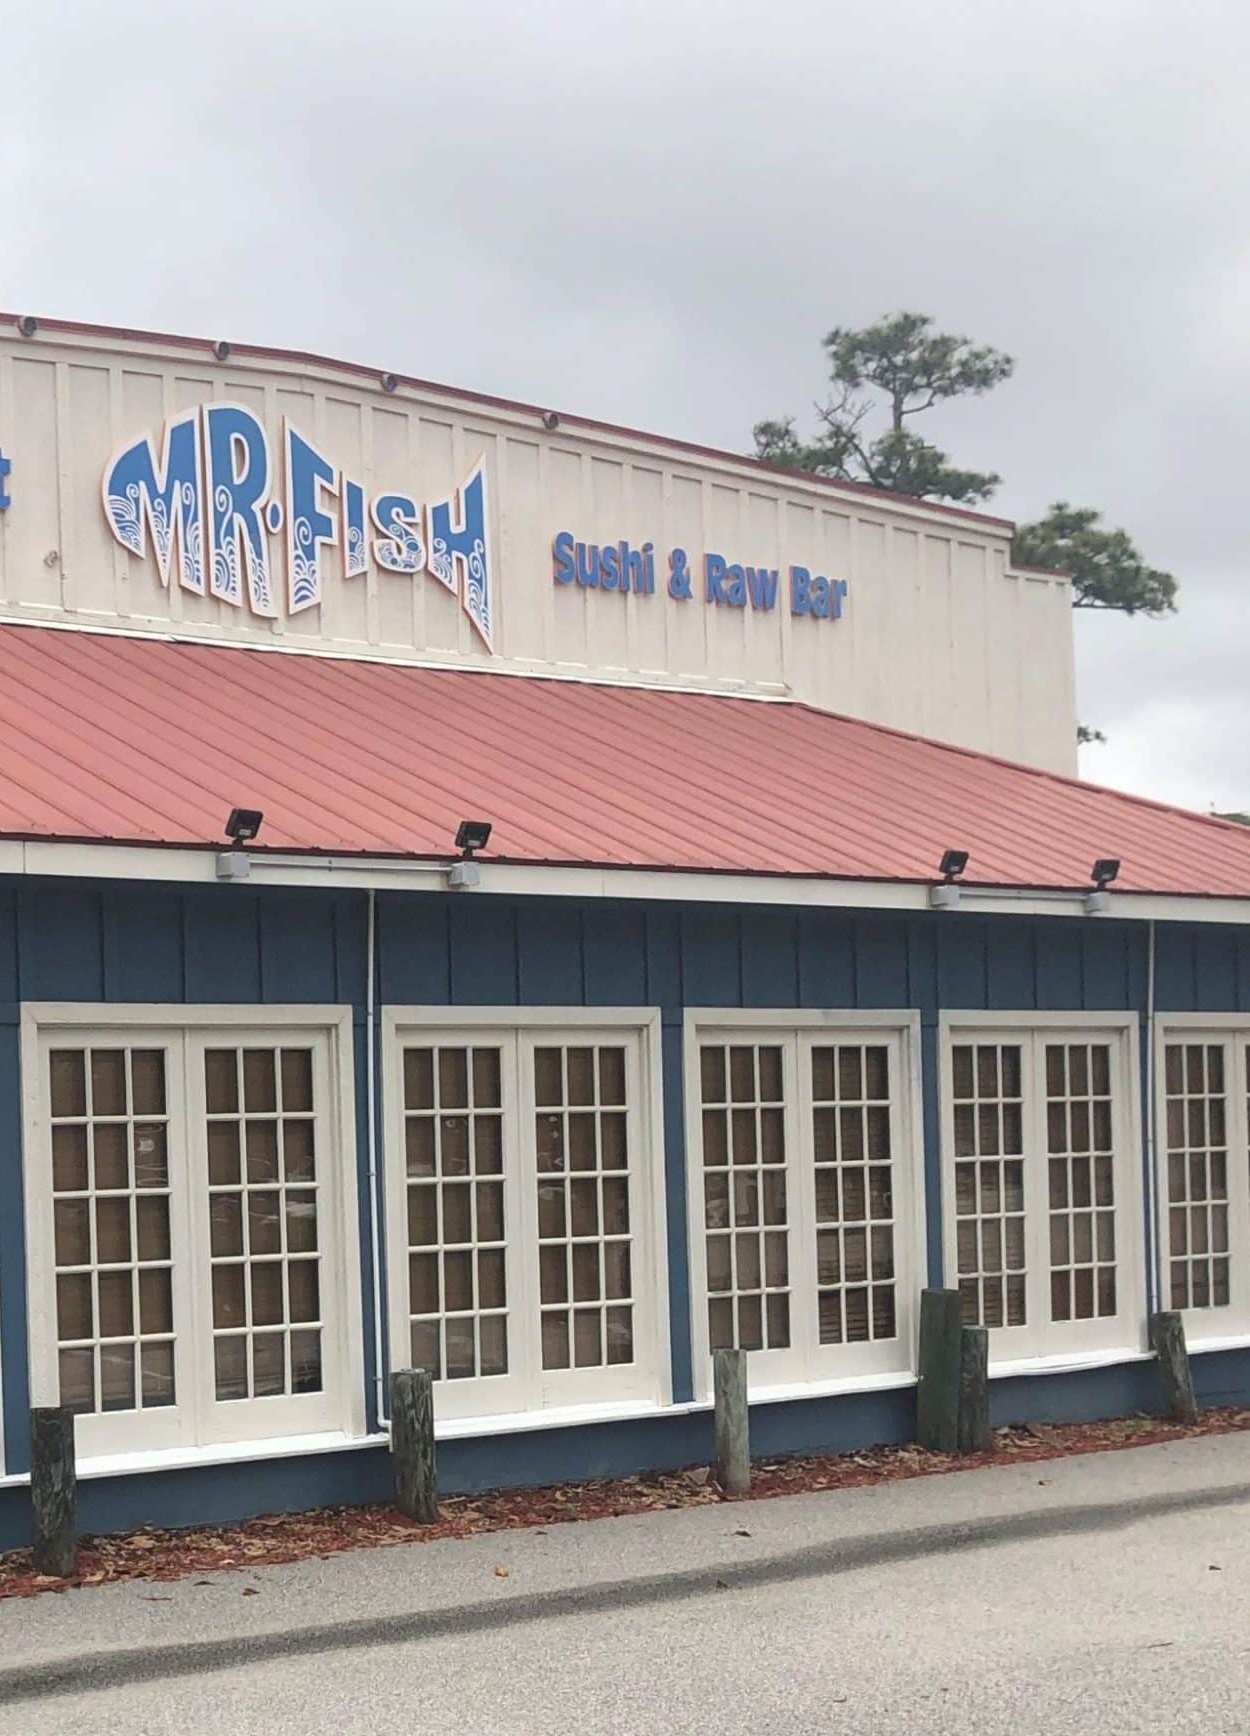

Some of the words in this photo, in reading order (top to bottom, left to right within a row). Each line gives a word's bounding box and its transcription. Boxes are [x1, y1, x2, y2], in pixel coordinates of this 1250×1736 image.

[552, 531, 655, 594] Sushi
[667, 547, 693, 600] &
[703, 552, 779, 611] Raw
[789, 565, 848, 619] Bar
